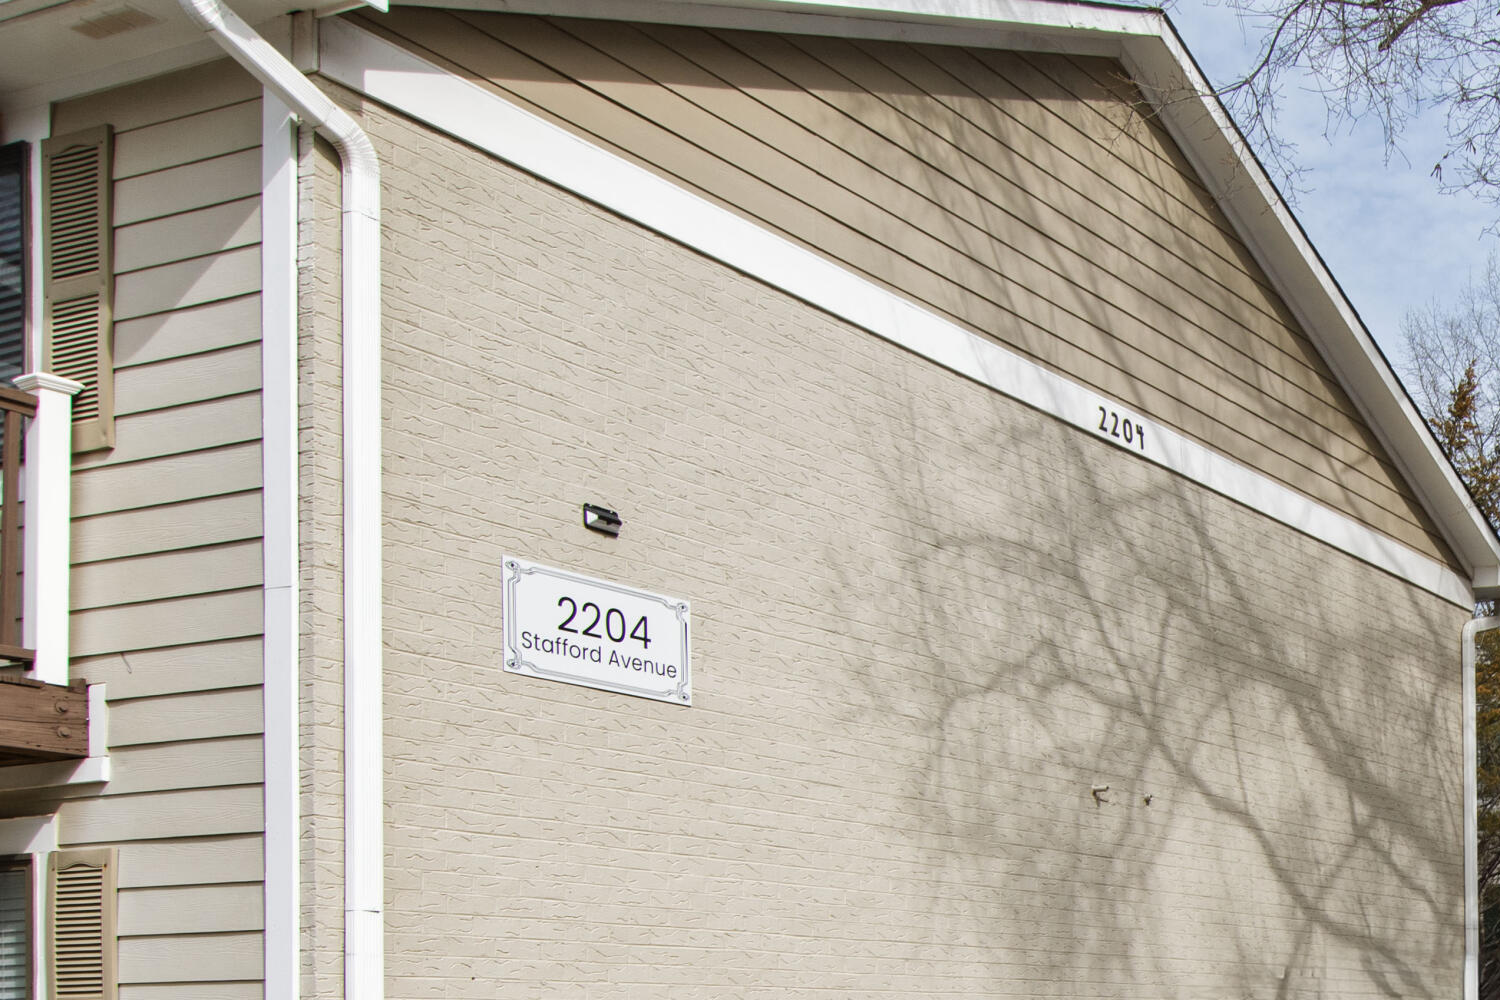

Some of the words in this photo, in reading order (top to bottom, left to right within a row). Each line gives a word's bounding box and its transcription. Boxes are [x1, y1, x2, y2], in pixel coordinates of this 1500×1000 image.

[1099, 406, 1144, 450] 2204
[557, 596, 652, 650] 2204
[521, 631, 601, 663] Stafford
[608, 650, 678, 679] Avenue
